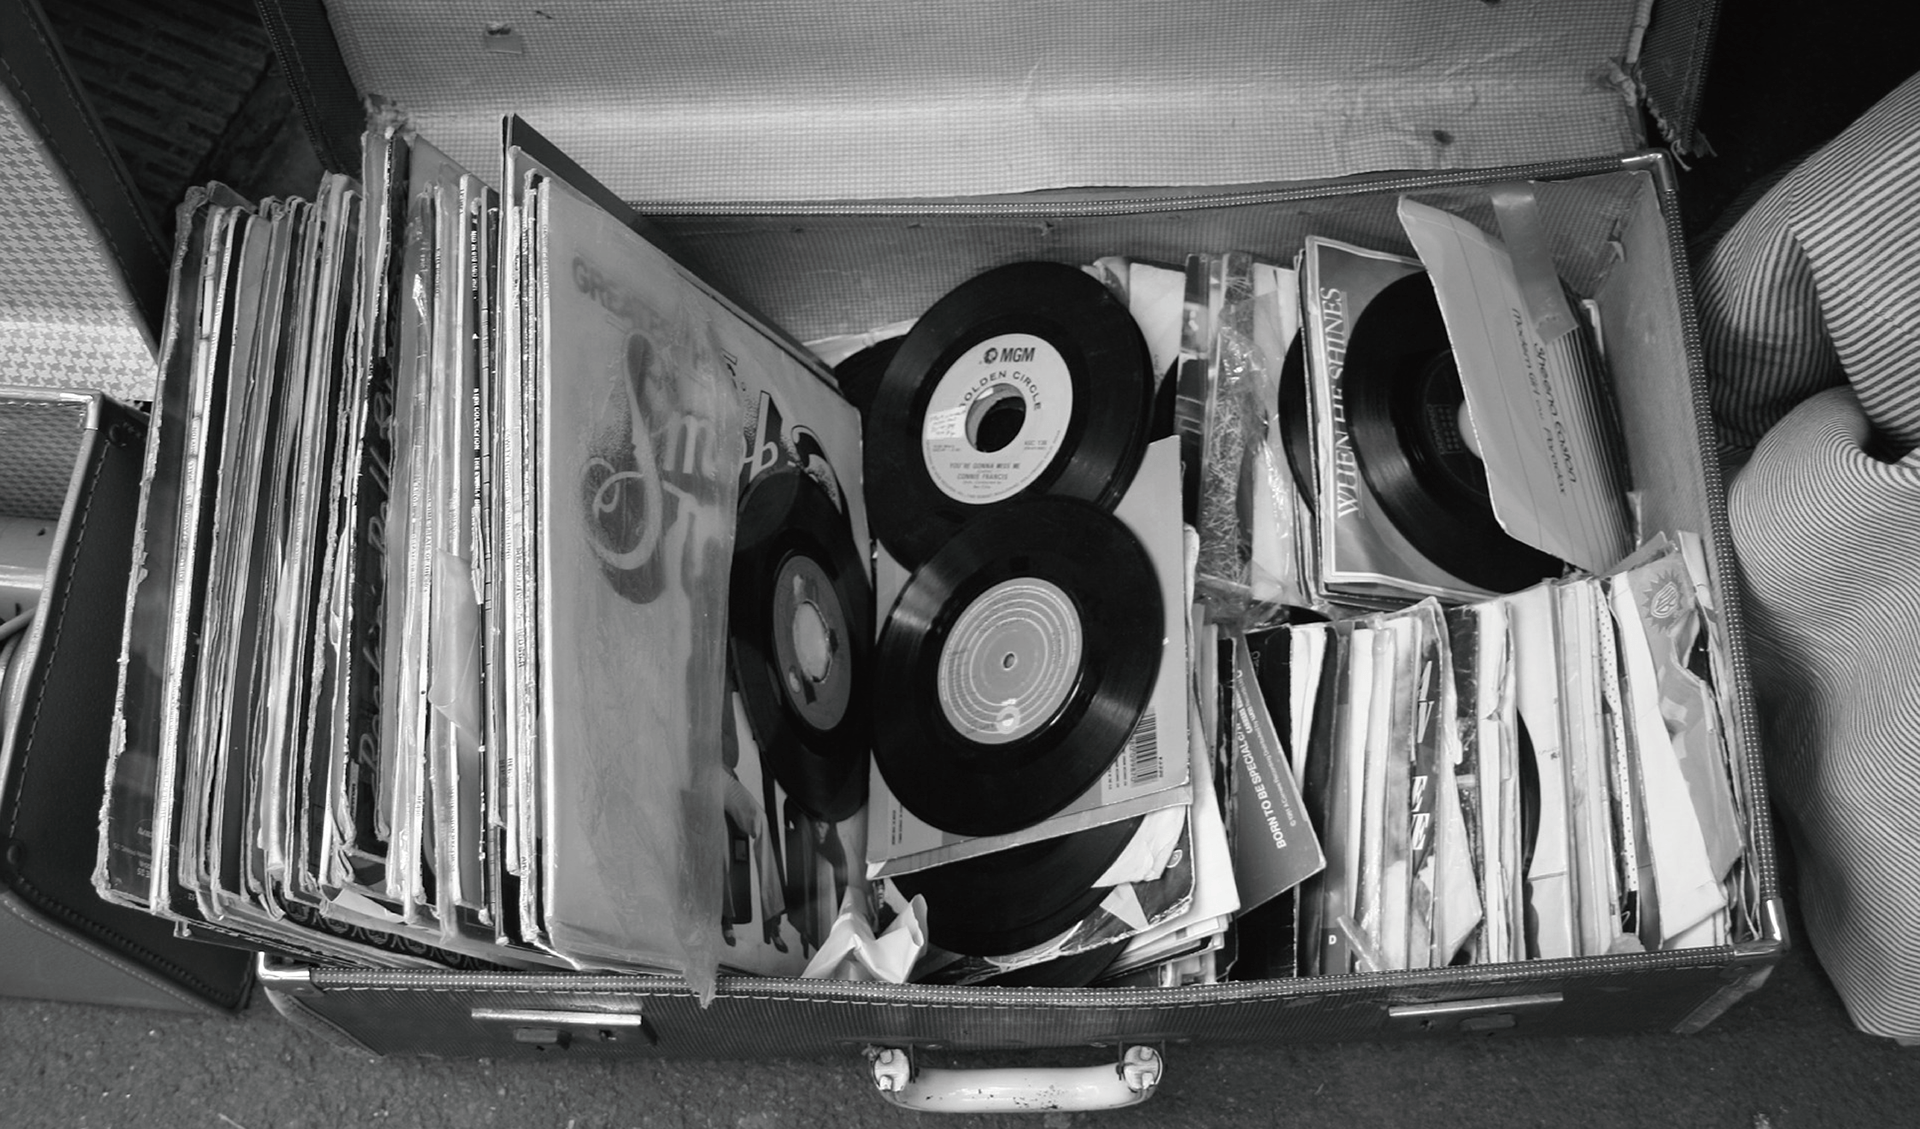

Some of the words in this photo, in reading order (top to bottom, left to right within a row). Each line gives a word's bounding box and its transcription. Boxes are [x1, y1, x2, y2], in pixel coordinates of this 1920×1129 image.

[1320, 287, 1346, 379] SHINES
[1000, 347, 1035, 362] MGM
[1013, 371, 1042, 411] CIRCLE
[1534, 343, 1559, 416] Sheena
[1555, 421, 1577, 483] Easton
[1335, 431, 1359, 517] WHEN
[1237, 743, 1263, 801] SPECIAL
[1254, 783, 1268, 800] BE
[1260, 799, 1274, 816] TO
[1266, 815, 1287, 849] BORN
